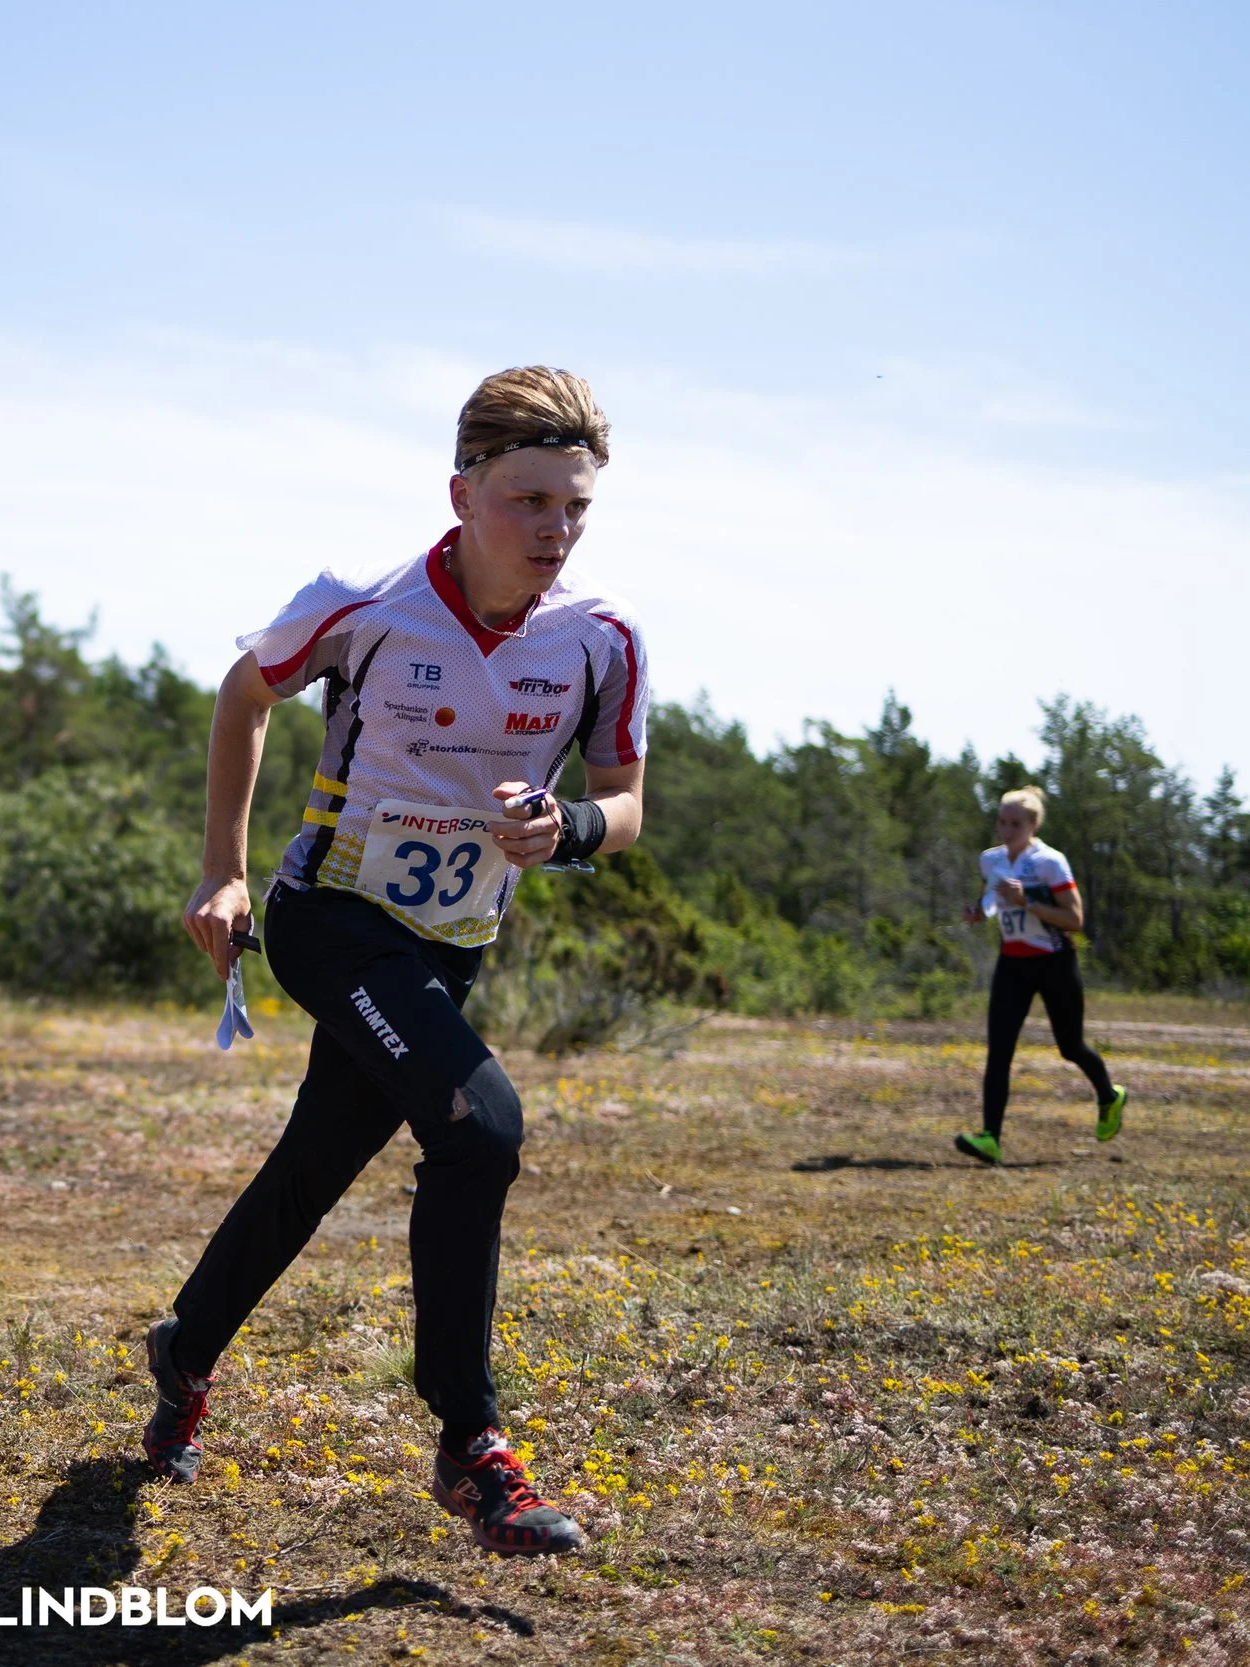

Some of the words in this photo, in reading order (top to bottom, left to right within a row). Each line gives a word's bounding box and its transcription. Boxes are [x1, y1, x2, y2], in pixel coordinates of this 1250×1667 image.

[409, 663, 442, 681] TB
[386, 840, 482, 907] 33
[350, 986, 410, 1060] TRIMTEX
